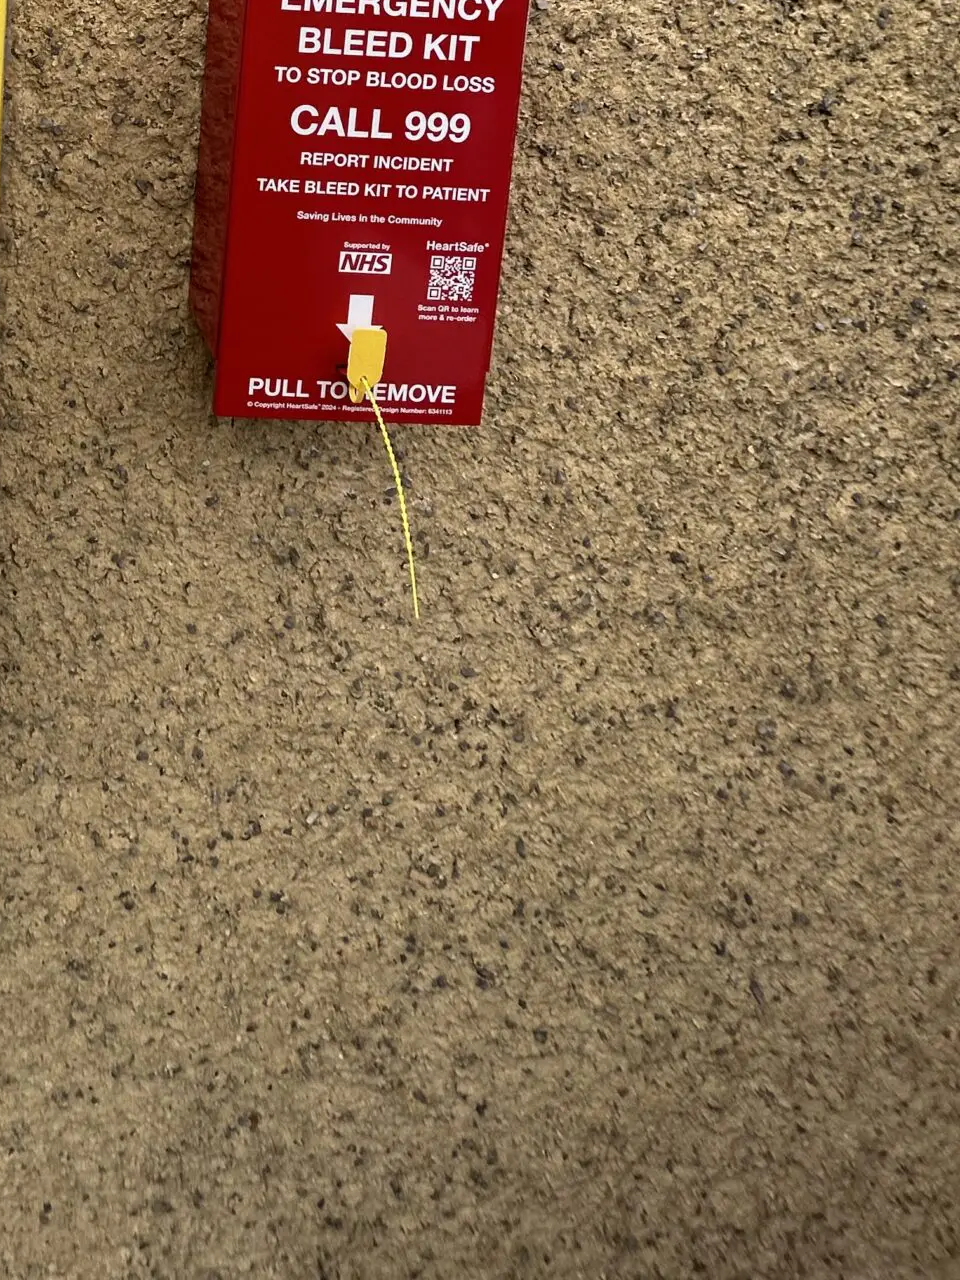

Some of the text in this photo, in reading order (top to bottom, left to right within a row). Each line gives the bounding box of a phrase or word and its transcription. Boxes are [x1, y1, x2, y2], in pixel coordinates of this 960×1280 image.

[298, 27, 480, 61] BLEED KIT
[275, 66, 495, 93] TO STOP BLOOD LOSS
[290, 104, 471, 143] CALL 999
[300, 152, 453, 172] REPORT INCIDENT
[257, 178, 490, 202] TAKE BLEED KIT TO PATIENT
[297, 210, 442, 228] Saving Lives in the Community
[344, 241, 390, 251] Supported by
[341, 254, 389, 272] NHS
[418, 304, 436, 312] Scan
[460, 306, 479, 314] learn
[248, 378, 456, 404] PULL TO EMOVE
[254, 401, 285, 409] Copyright
[400, 407, 426, 415] Number:
